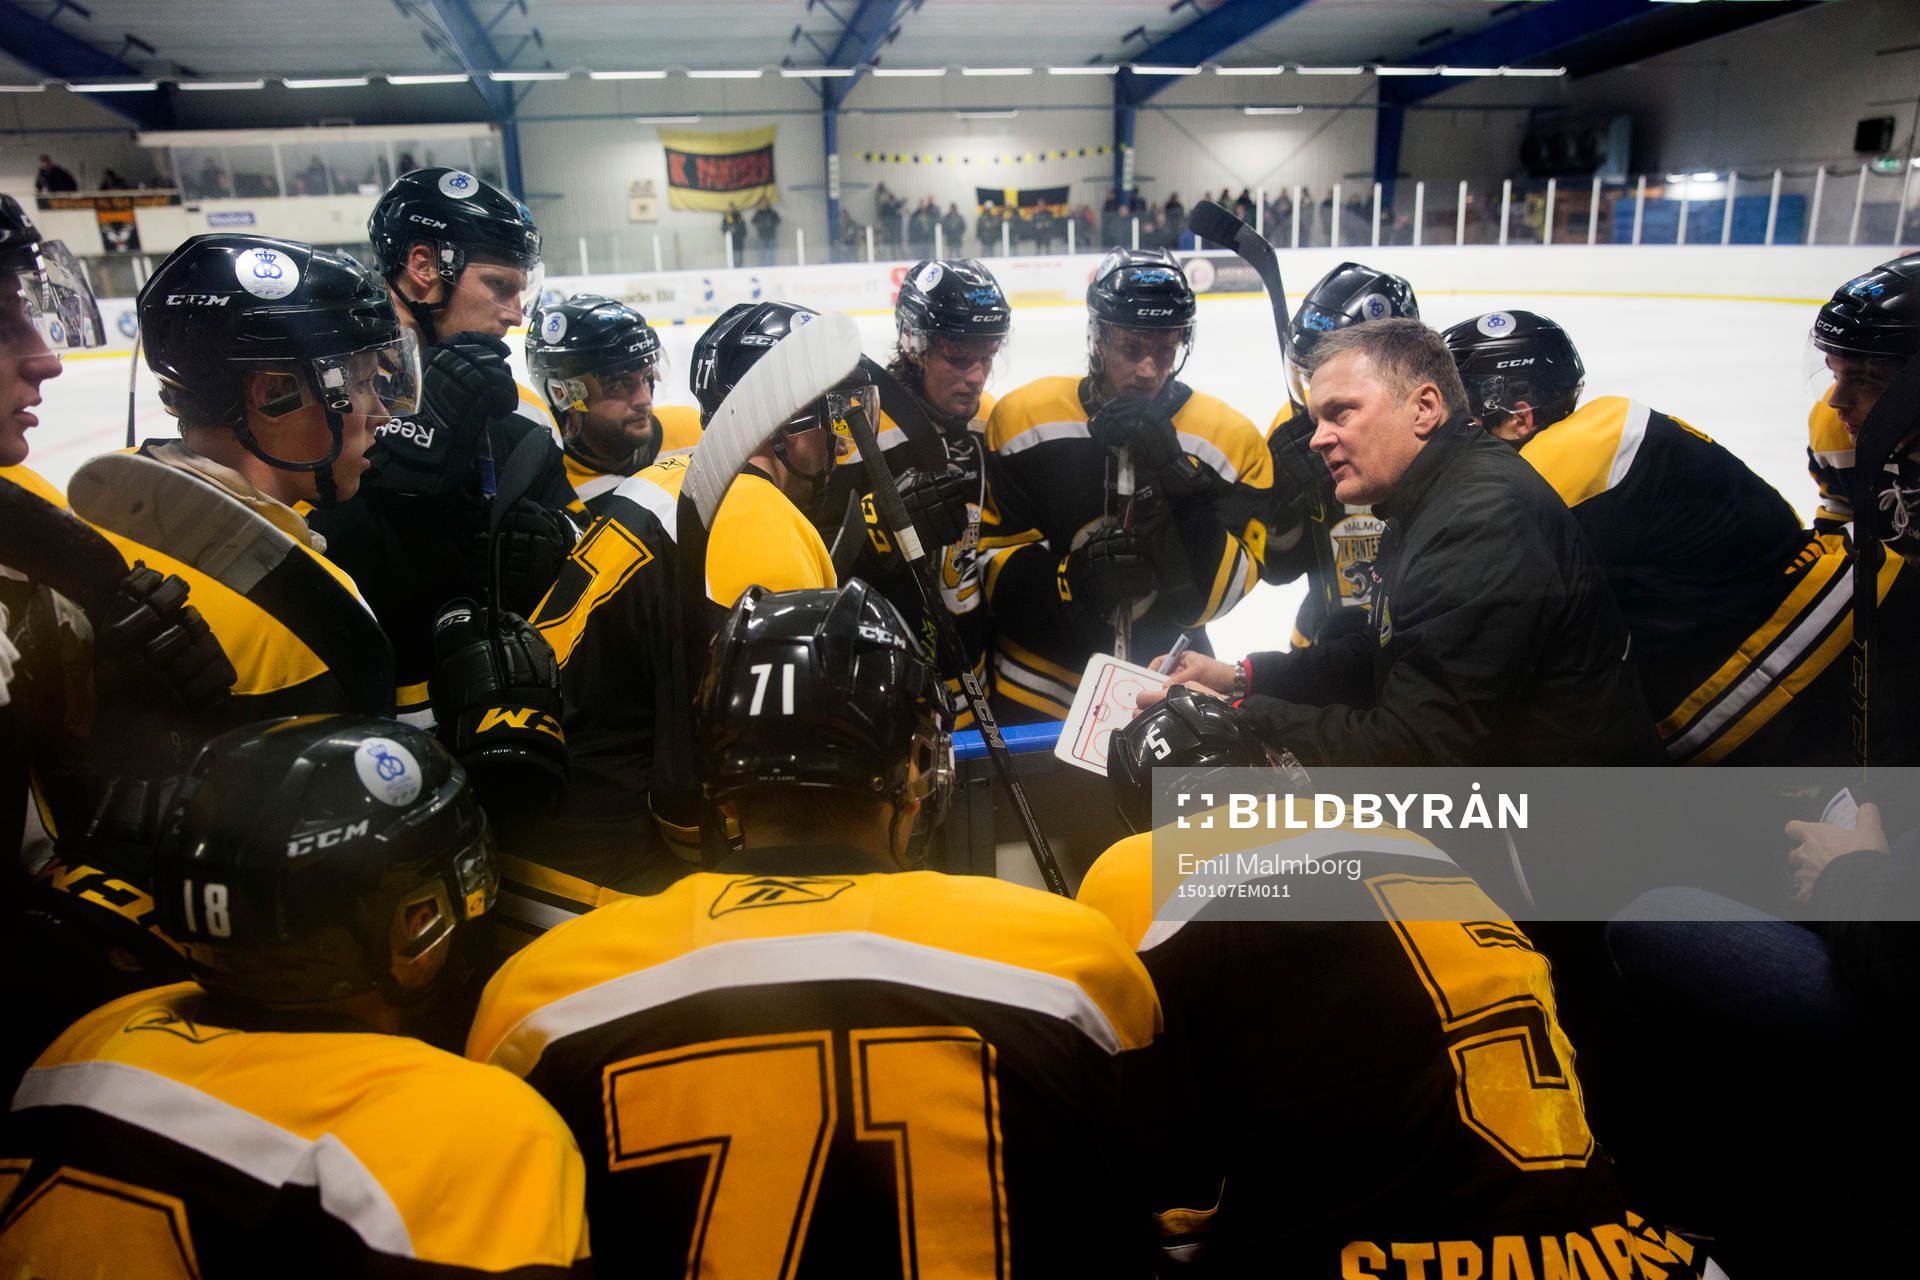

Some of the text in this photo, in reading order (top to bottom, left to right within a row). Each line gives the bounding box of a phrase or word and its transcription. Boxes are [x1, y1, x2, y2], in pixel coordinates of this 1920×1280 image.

[409, 214, 448, 230] CCM
[165, 294, 231, 307] CCM
[971, 315, 1002, 323] CCM
[1136, 308, 1174, 317] CCM
[1816, 320, 1845, 335] CCM
[628, 339, 655, 353] CCM
[1496, 358, 1536, 369] CCM
[858, 625, 907, 650] CCM
[749, 663, 796, 717] 71
[961, 669, 1007, 749] CCM
[1145, 727, 1172, 761] 5
[286, 819, 370, 857] CCM
[183, 878, 231, 938] 18
[602, 1026, 1012, 1280] 71
